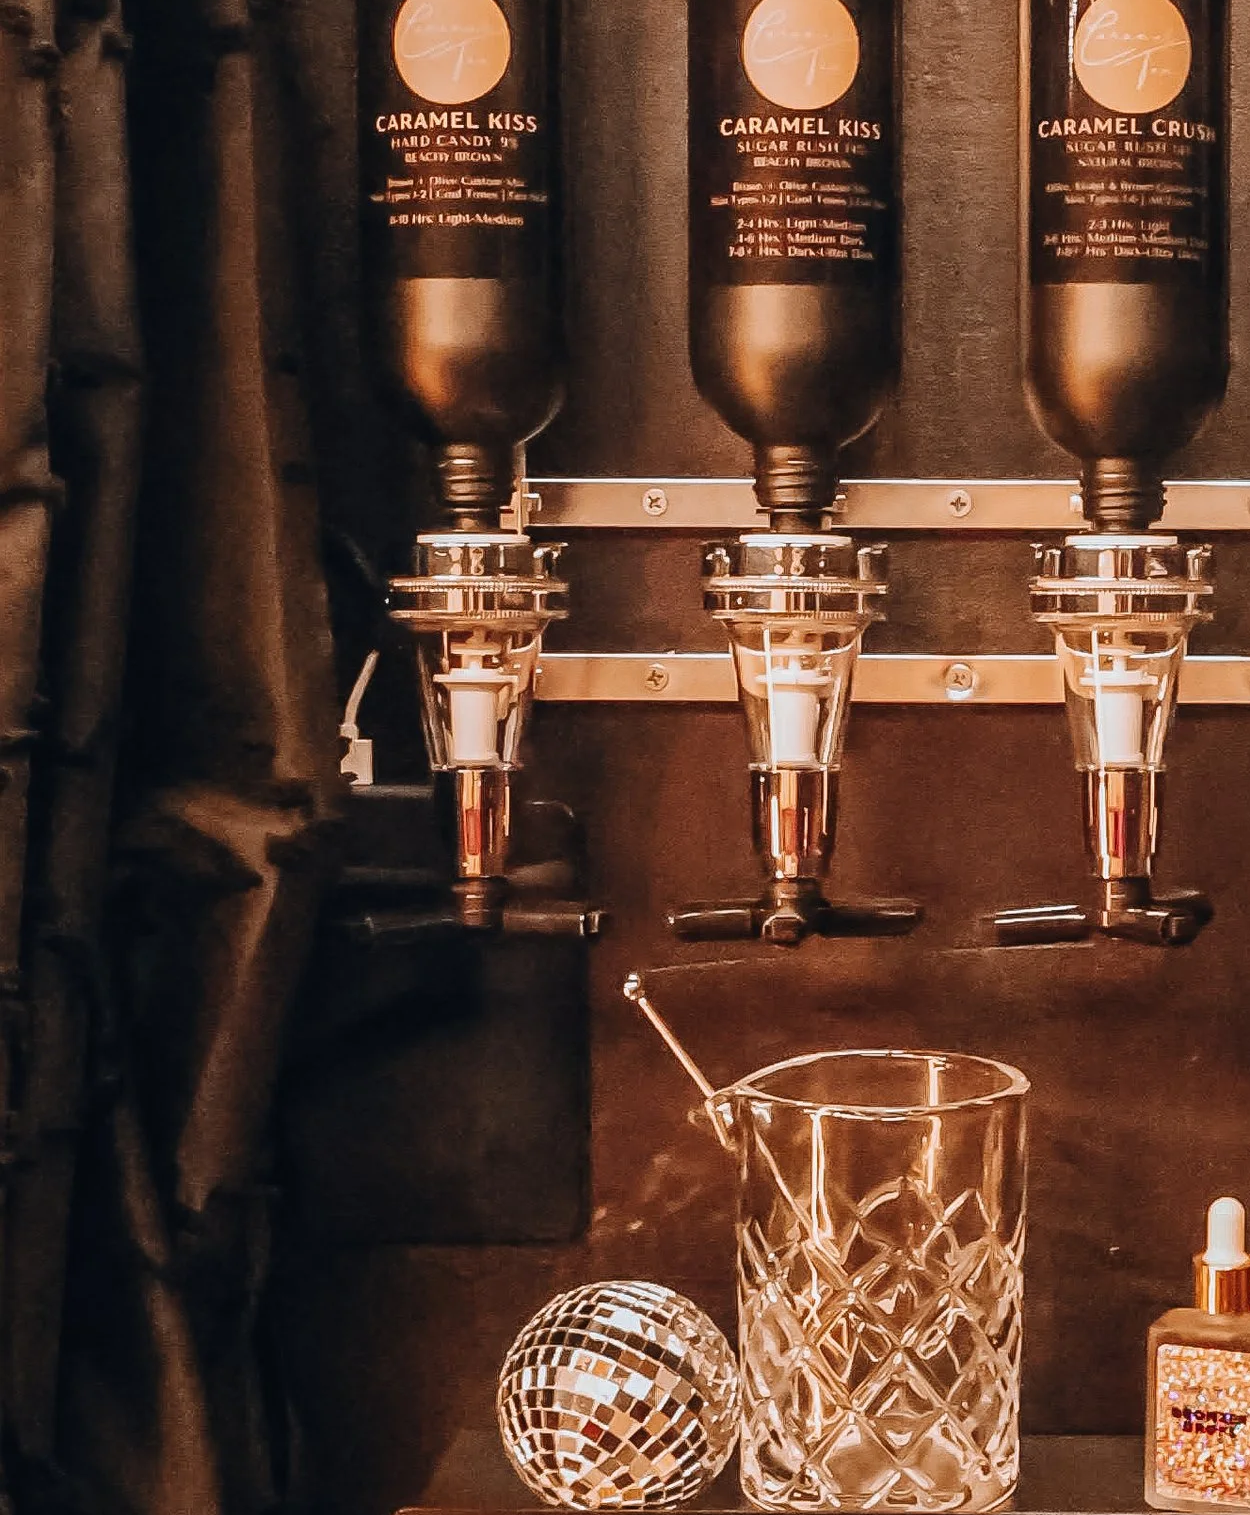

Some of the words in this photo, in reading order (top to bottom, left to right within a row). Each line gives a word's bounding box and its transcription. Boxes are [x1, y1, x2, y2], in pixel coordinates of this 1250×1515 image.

[376, 111, 480, 132] CARAMEL
[488, 112, 537, 133] KISS
[720, 117, 830, 136] CARAMEL
[838, 119, 881, 140] KISS
[1038, 117, 1142, 137] CARAMEL
[1151, 119, 1216, 142] CRUSH
[391, 135, 430, 150] HARD
[436, 135, 492, 147] CANDY
[737, 140, 788, 153] SUGAR
[796, 140, 839, 153] RUSH
[1066, 140, 1117, 153] SUGAR
[455, 152, 503, 163] BROWN
